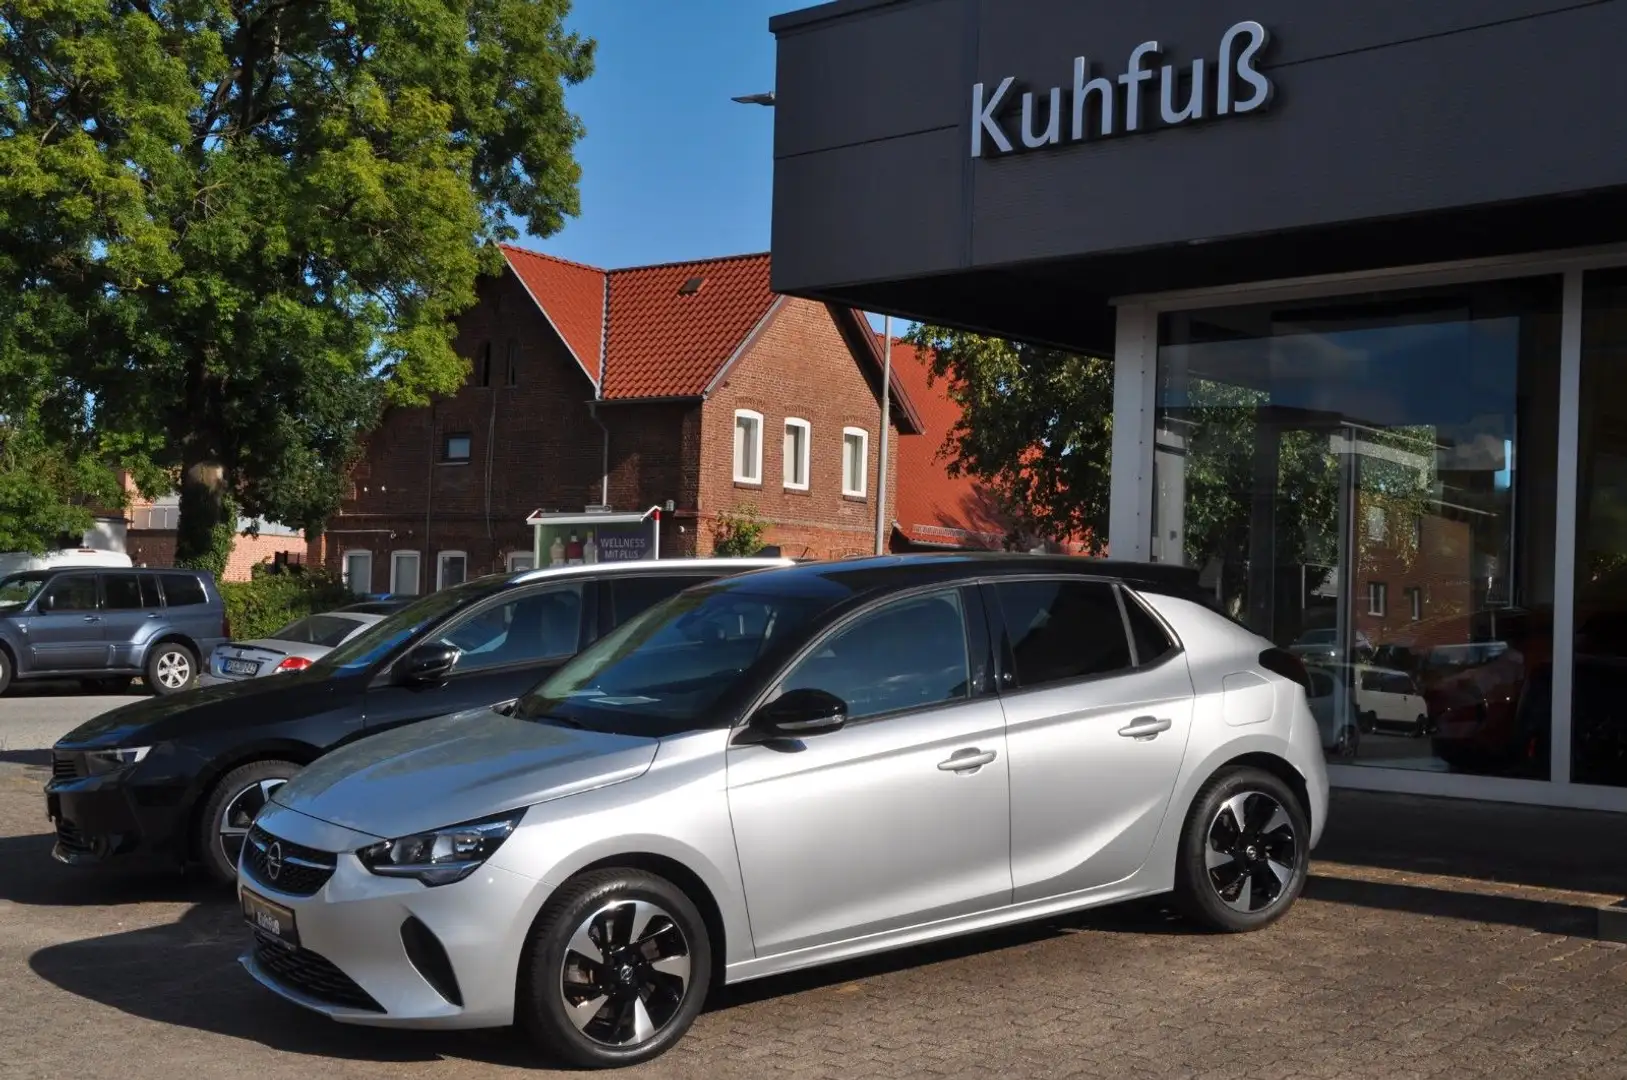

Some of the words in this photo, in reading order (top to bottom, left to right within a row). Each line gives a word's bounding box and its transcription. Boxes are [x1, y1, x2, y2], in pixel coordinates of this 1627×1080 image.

[971, 20, 1271, 157] Kuhfuß
[600, 538, 645, 548] WELLNESS
[604, 550, 619, 559] MIT
